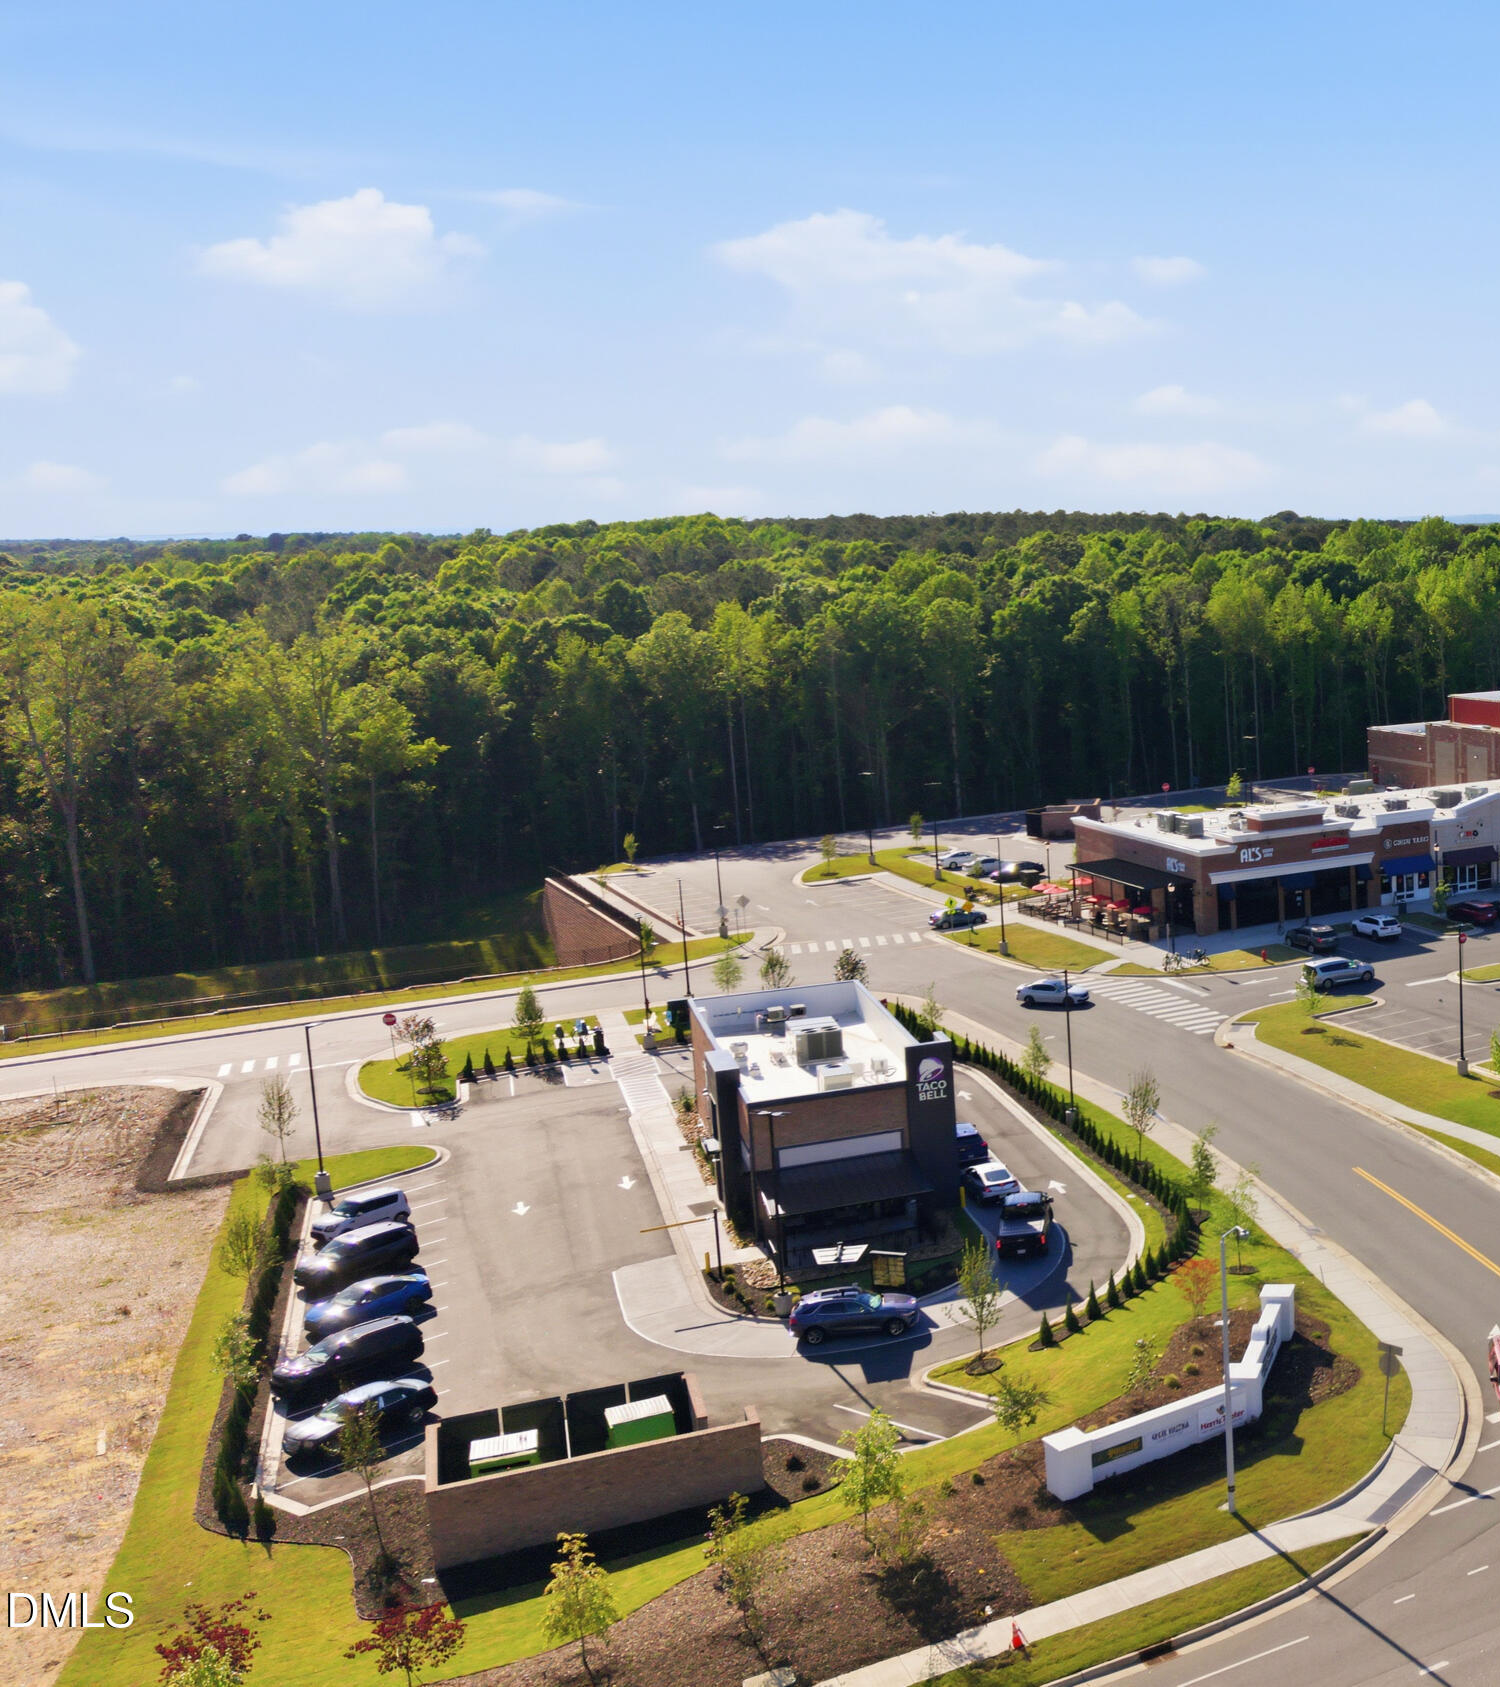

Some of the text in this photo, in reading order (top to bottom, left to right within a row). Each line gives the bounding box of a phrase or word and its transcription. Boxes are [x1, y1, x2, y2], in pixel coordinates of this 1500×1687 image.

[1240, 847, 1263, 863] AL'S
[916, 1080, 947, 1092] TACO
[919, 1089, 947, 1101] BELL
